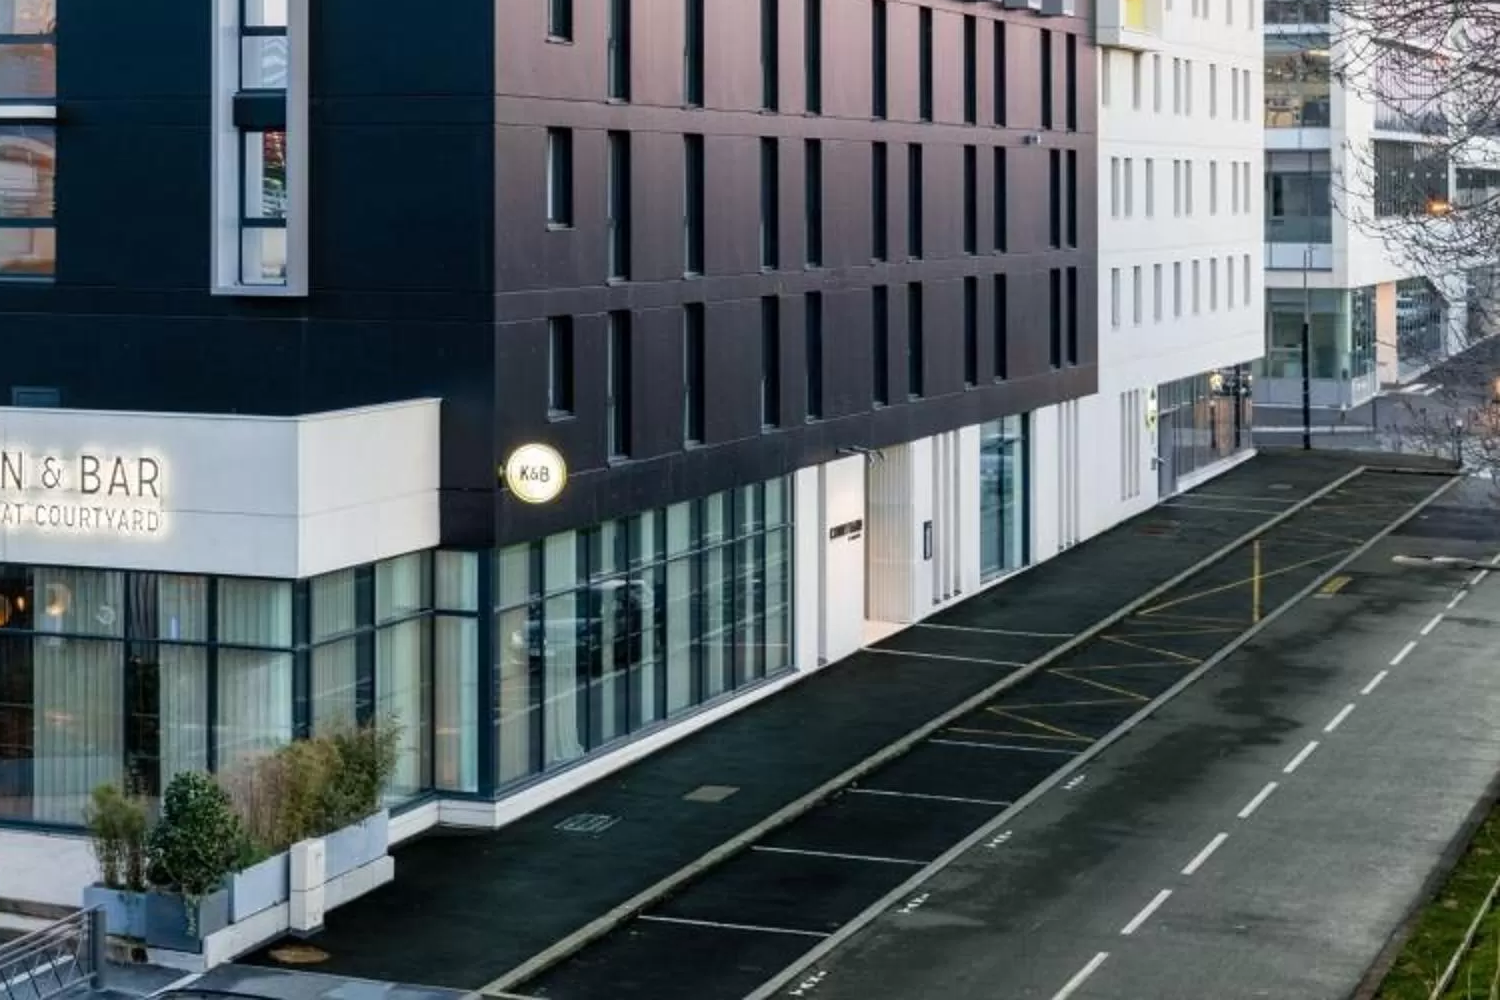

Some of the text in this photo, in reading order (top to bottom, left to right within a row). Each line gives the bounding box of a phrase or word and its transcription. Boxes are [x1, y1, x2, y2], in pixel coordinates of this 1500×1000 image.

[41, 456, 62, 489] &
[81, 454, 160, 498] BAR
[520, 465, 550, 483] K&B
[2, 503, 160, 532] AT COURTYARD
